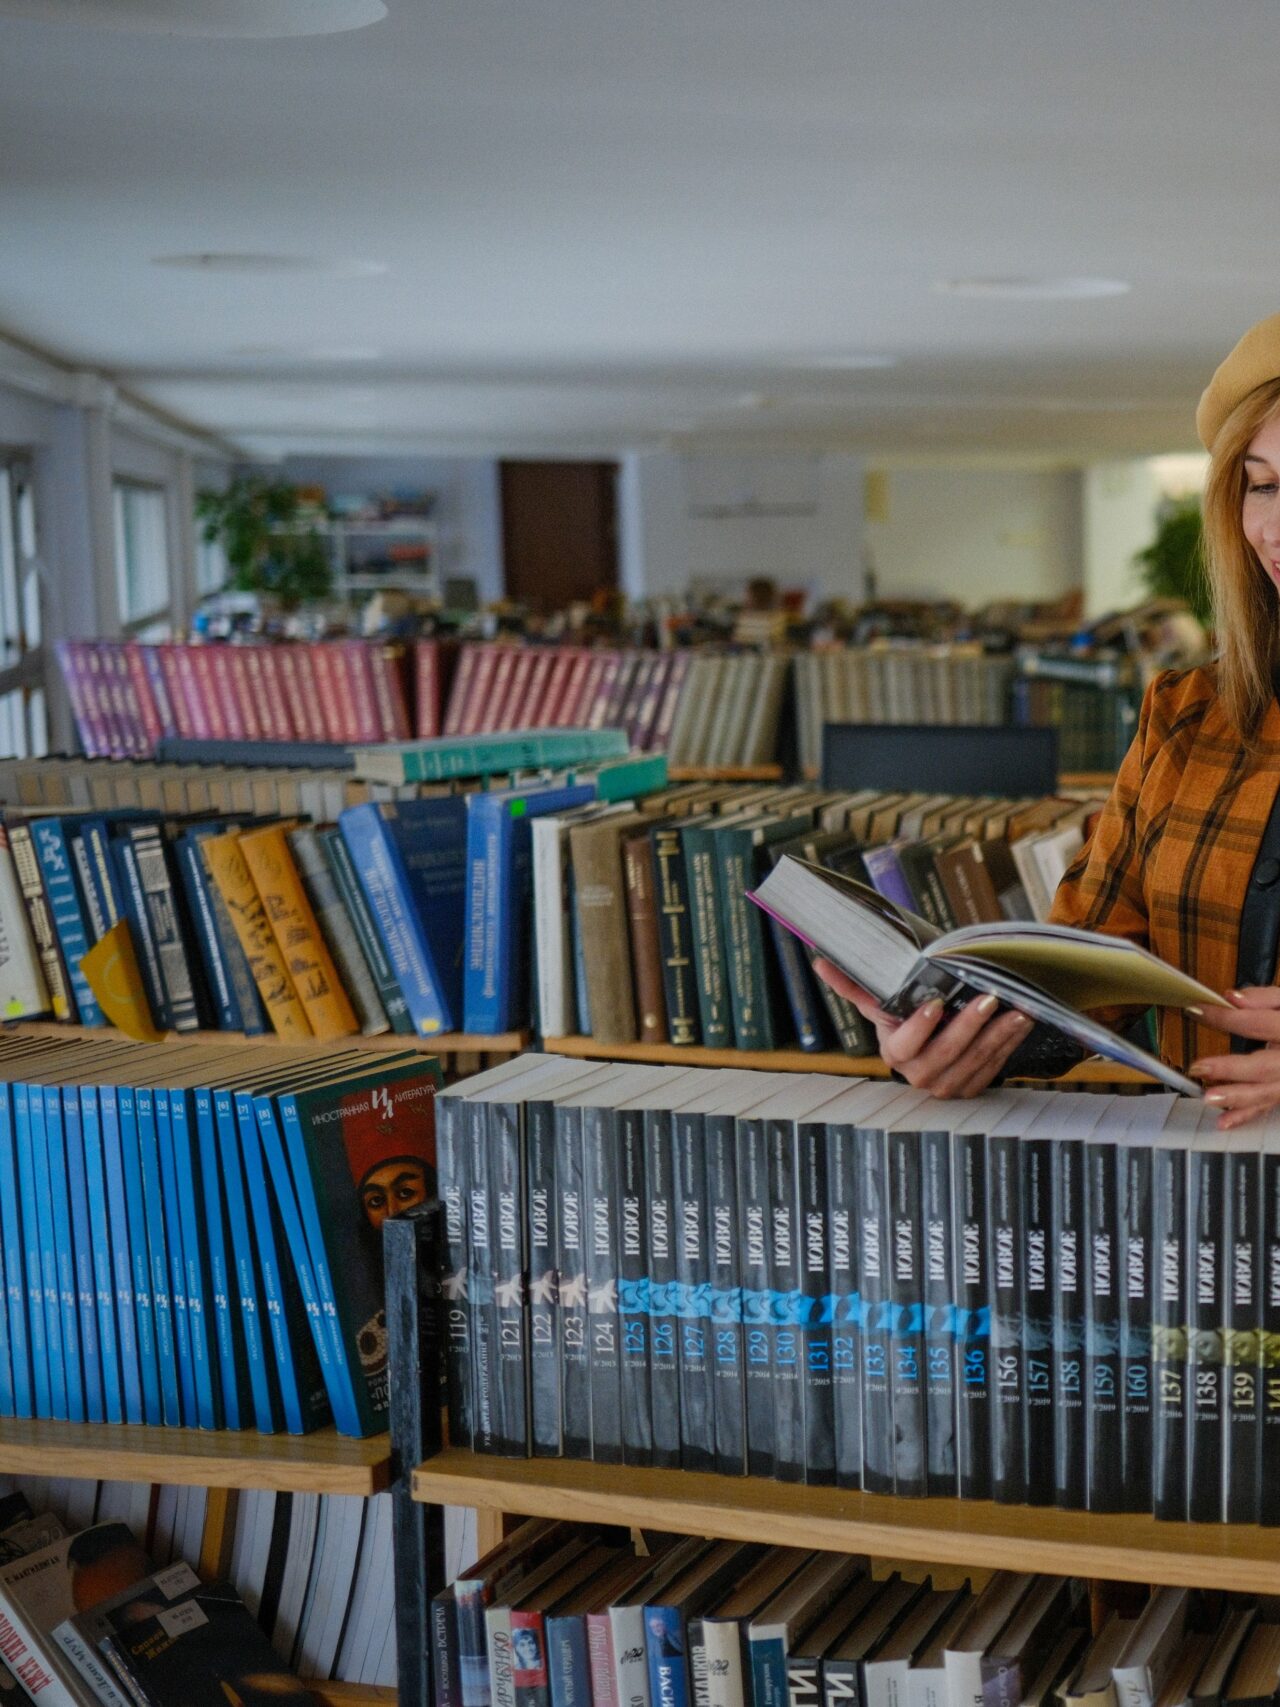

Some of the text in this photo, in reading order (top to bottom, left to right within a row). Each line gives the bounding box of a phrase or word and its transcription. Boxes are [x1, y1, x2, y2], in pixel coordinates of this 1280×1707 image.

[312, 1102, 370, 1125] ИНОСТРАННАЯ
[394, 1084, 437, 1104] ЛИТЕРАТУРА
[446, 1186, 462, 1243] НОВОЕ
[472, 1190, 488, 1248] НОВОЕ
[500, 1192, 515, 1249] НОВОЕ
[533, 1189, 548, 1246] НОВОЕ
[564, 1192, 579, 1249] НОВОЕ
[594, 1198, 609, 1255] НОВОЕ
[624, 1197, 640, 1255] НОВОЕ
[652, 1200, 668, 1258] НОВОЕ
[684, 1201, 700, 1259] НОВОЕ
[715, 1206, 731, 1264] НОВОЕ
[747, 1207, 764, 1265] НОВОЕ
[774, 1207, 791, 1266] НОВОЕ
[807, 1212, 824, 1272] НОВОЕ
[833, 1211, 849, 1270] НОВОЕ
[863, 1218, 880, 1277] НОВОЕ
[896, 1220, 913, 1280] НОВОЕ
[928, 1220, 945, 1280] НОВОЕ
[963, 1224, 980, 1284] НОВОЕ
[997, 1227, 1014, 1288] НОВОЕ
[1028, 1230, 1045, 1290] НОВОЕ
[1061, 1231, 1077, 1292] НОВОЕ
[1094, 1234, 1111, 1296] НОВОЕ
[1128, 1237, 1145, 1298] НОВОЕ
[1162, 1240, 1179, 1301] НОВОЕ
[1198, 1242, 1215, 1304] НОВОЕ
[1235, 1243, 1251, 1305] НОВОЕ
[450, 1309, 468, 1340] 119
[502, 1319, 520, 1348] 121
[533, 1313, 551, 1344] 122
[565, 1316, 584, 1347] 123
[595, 1322, 615, 1353] 124
[625, 1321, 644, 1353] 125
[655, 1324, 673, 1356] 126
[685, 1325, 704, 1357] 127
[717, 1331, 736, 1363] 128
[750, 1331, 768, 1364] 129
[777, 1332, 796, 1365] 130
[808, 1340, 829, 1371] 131
[834, 1337, 853, 1370] 132
[865, 1344, 885, 1377] 133
[898, 1346, 917, 1380] 134
[930, 1348, 949, 1380] 135
[964, 1350, 985, 1384] 136
[998, 1355, 1017, 1389] 156
[1029, 1359, 1049, 1391] 157
[1061, 1360, 1080, 1392] 158
[1094, 1363, 1114, 1397] 159
[1127, 1364, 1148, 1398] 160
[1160, 1369, 1182, 1405] 137
[1196, 1371, 1217, 1407] 138
[1233, 1372, 1255, 1409] 139
[63, 1636, 86, 1664] МУР
[16, 1656, 54, 1696] ДЖЕК
